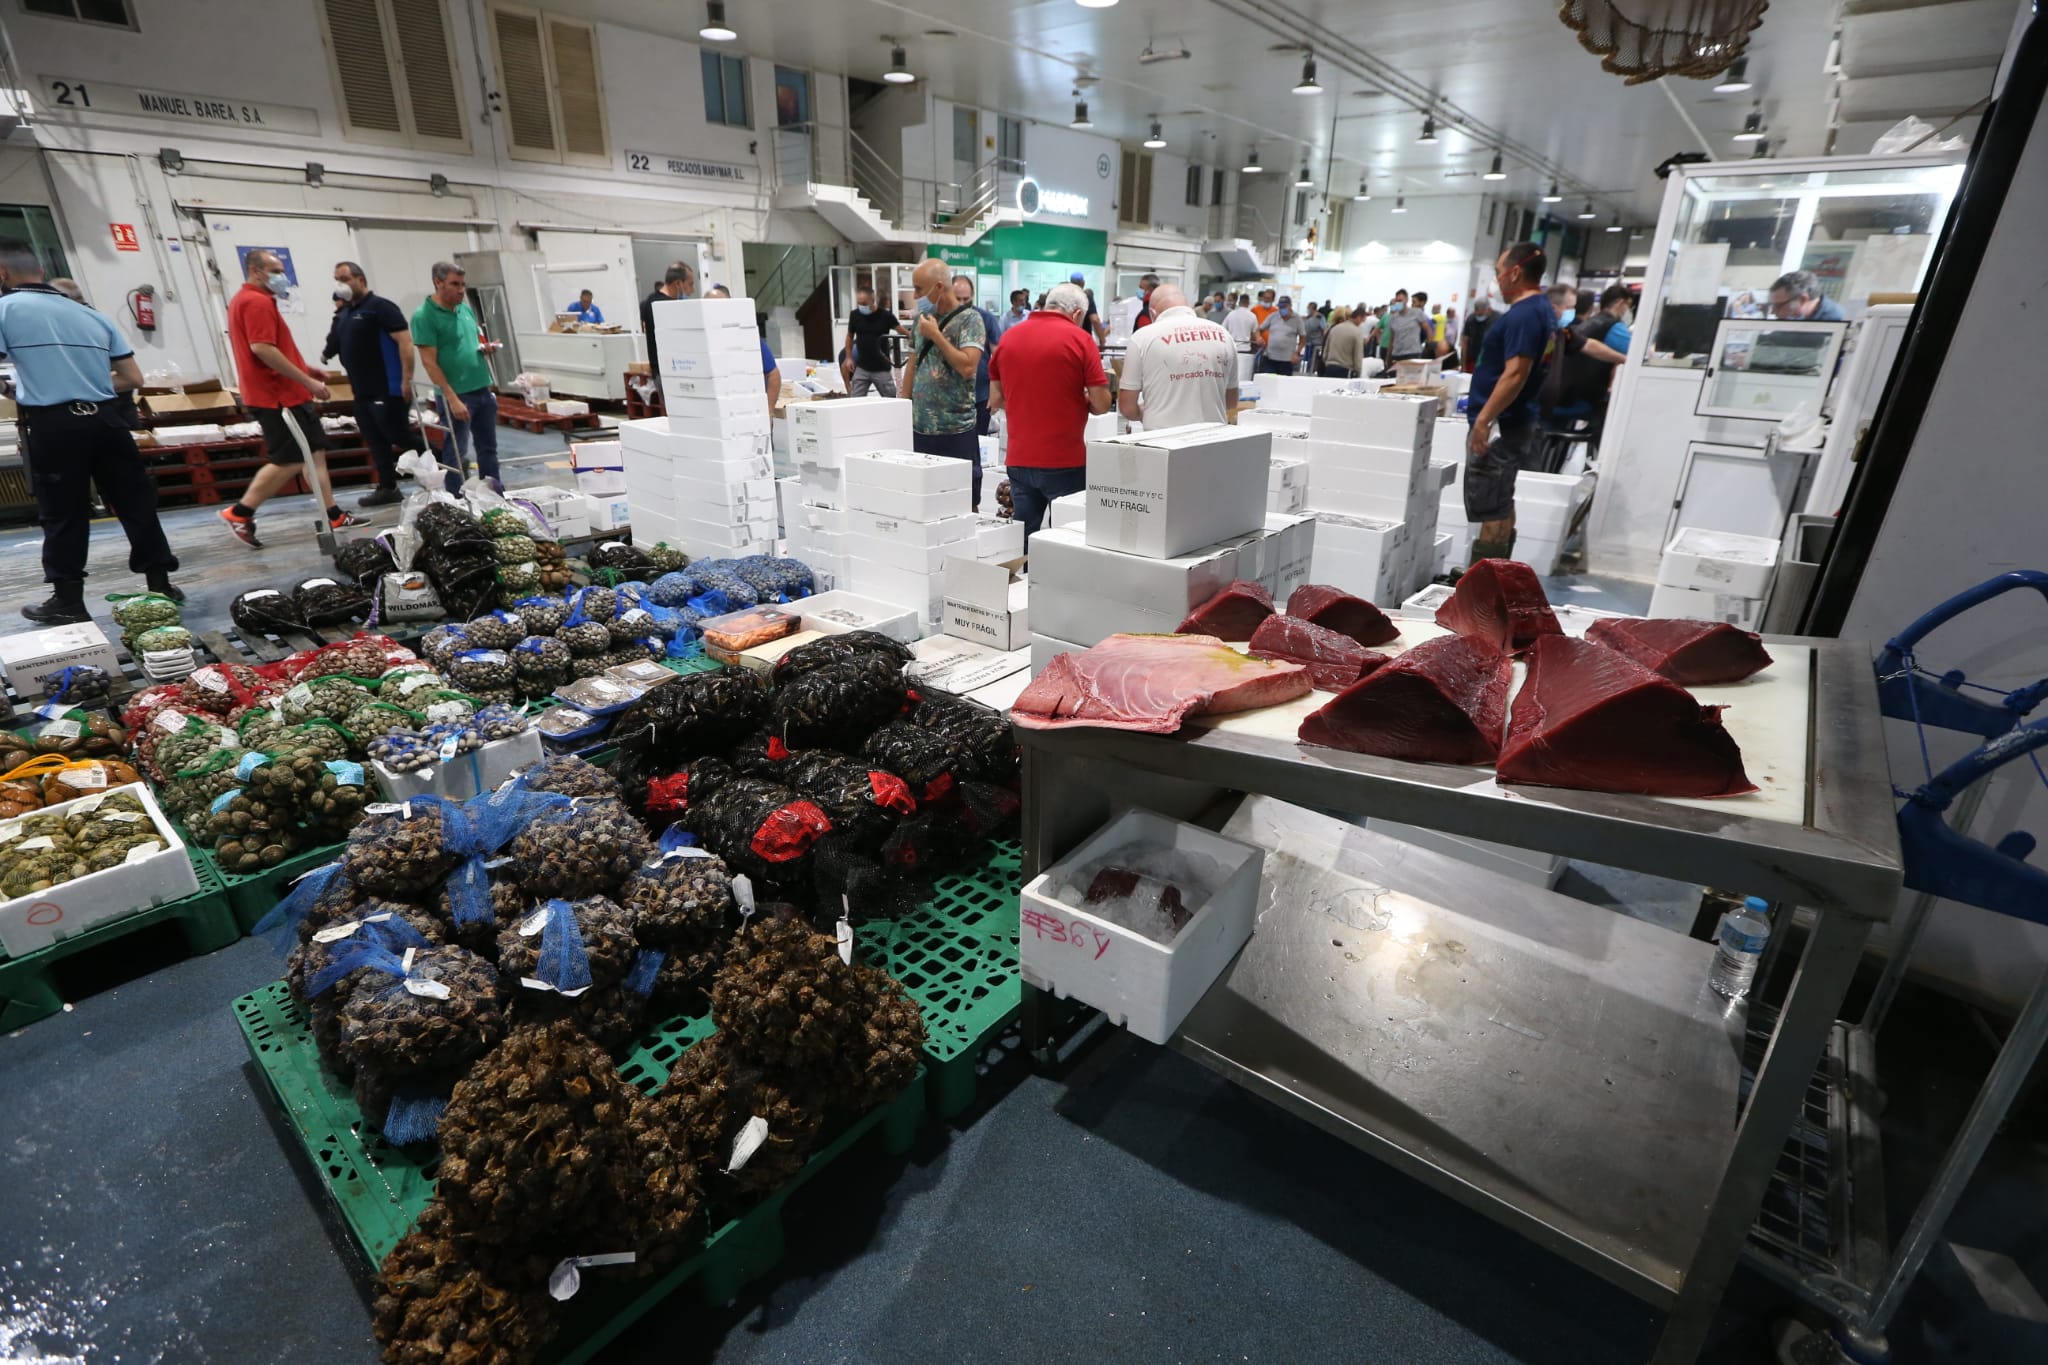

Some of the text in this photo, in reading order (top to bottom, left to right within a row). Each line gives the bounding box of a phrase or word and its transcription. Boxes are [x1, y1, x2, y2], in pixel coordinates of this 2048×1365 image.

[52, 81, 91, 107] 21
[138, 94, 192, 116] MANUEL
[631, 154, 650, 171] 22
[667, 160, 701, 176] PESCADOS
[1161, 331, 1227, 346] VICENTE
[1088, 484, 1119, 495] MANTENER
[1119, 488, 1138, 497] ENTRE
[1100, 498, 1119, 508] MUY
[954, 617, 970, 628] MUY
[15, 659, 55, 671] MANTENER
[55, 653, 79, 664] ENTRE
